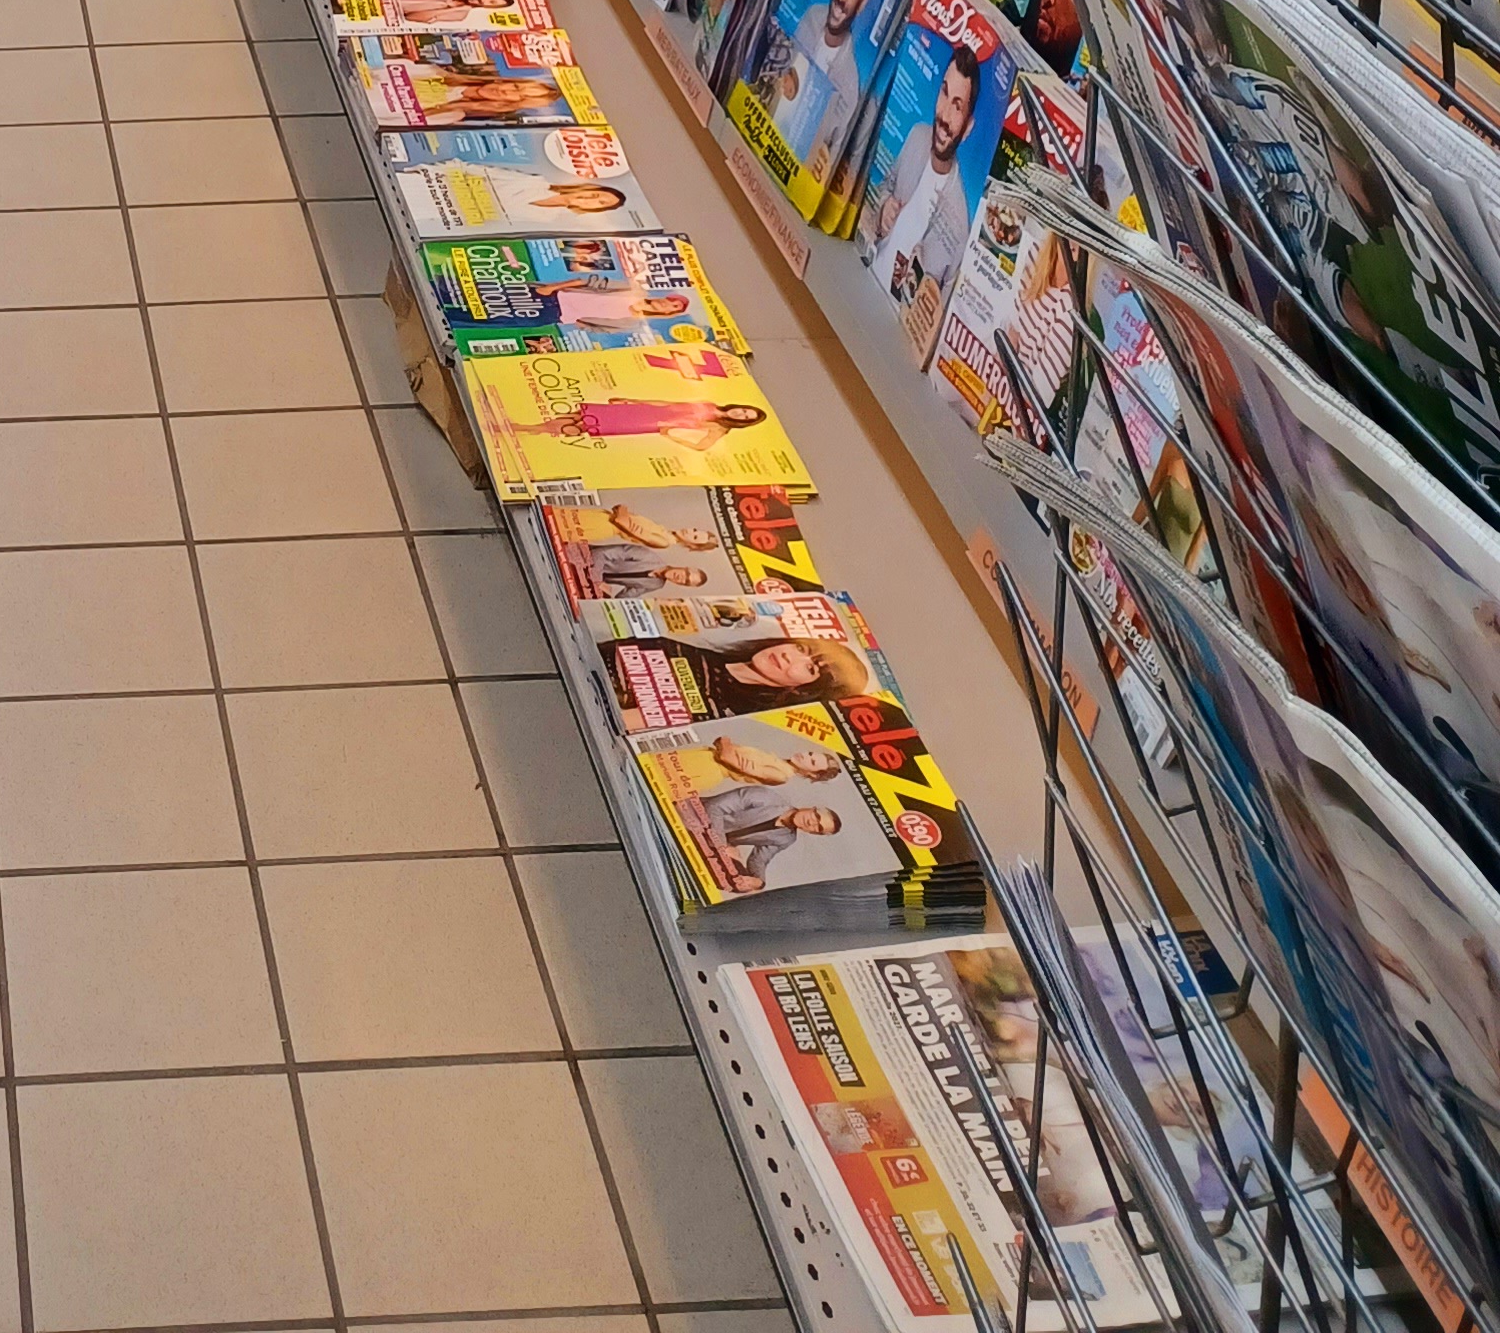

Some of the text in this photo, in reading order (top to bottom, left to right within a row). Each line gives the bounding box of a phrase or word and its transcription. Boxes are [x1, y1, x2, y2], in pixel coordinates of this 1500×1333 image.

[743, 95, 767, 129] OFFRE
[560, 128, 596, 180] loisirs
[584, 128, 620, 171] Télé
[466, 245, 514, 320] Chamoux
[499, 262, 541, 319] Camille
[638, 239, 671, 292] CABLE
[653, 237, 693, 289] TÉLÉ
[531, 356, 592, 451] Coudray
[804, 598, 846, 640] TÉLÉ
[783, 718, 835, 743] TNT
[838, 694, 920, 770] Télé
[859, 753, 959, 868] Z
[871, 805, 898, 839] JUILLET
[767, 974, 817, 1052] DU RC LENS
[792, 971, 860, 1086] LA FOLLE SAISON
[882, 962, 1015, 1194] GARDE LA MAIN
[1357, 1151, 1451, 1308] HISTOIRE
[909, 1245, 948, 1306] MOMENT
